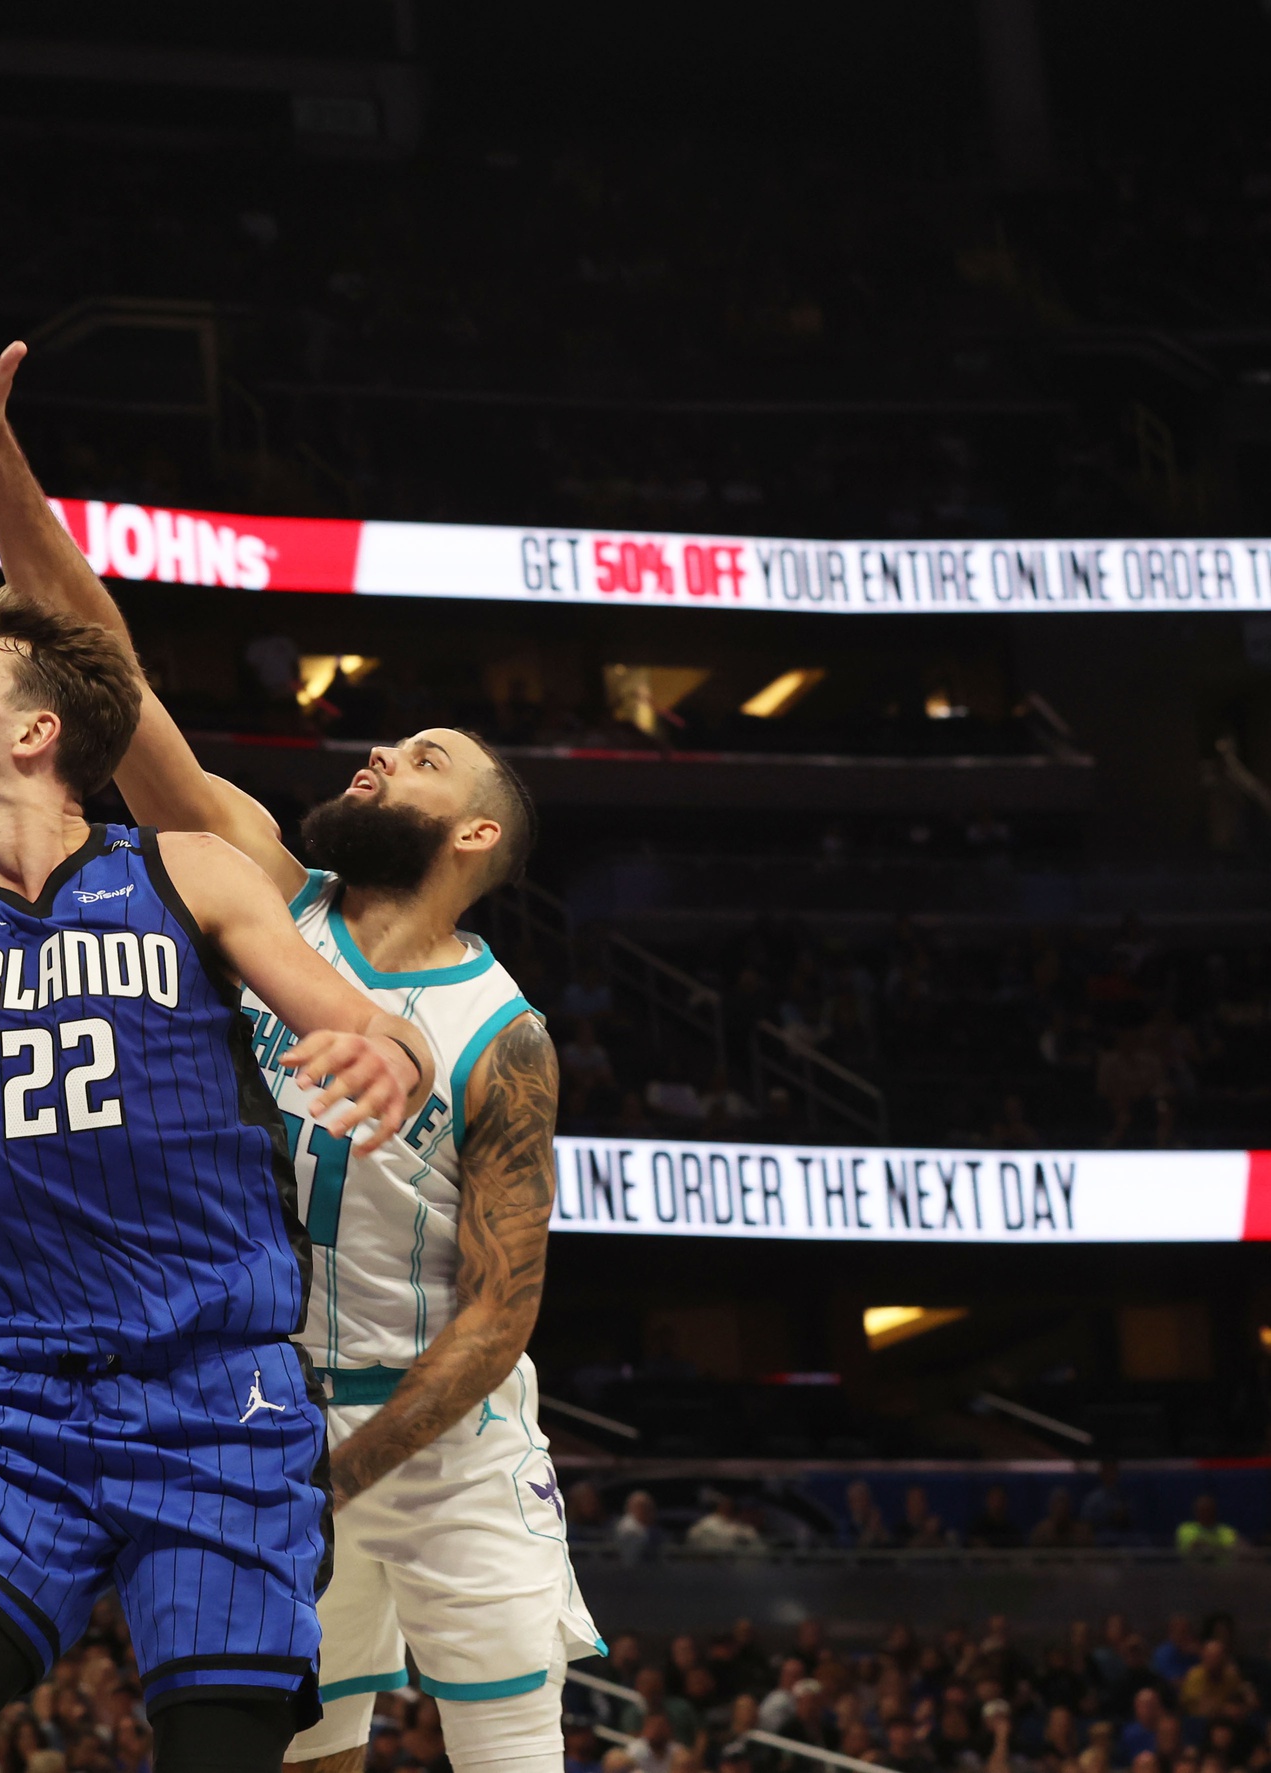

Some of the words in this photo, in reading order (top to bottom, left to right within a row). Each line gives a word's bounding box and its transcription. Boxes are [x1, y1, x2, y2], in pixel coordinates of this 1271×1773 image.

[84, 500, 270, 590] JOHNS
[521, 536, 580, 591] GET
[594, 540, 675, 595] 50%
[683, 545, 746, 597] OFF
[755, 548, 849, 601] YOUR
[860, 550, 979, 602] ENTIRE
[992, 550, 1110, 601] ONLINE
[1123, 549, 1237, 600] ORDER
[1247, 548, 1271, 600] T
[72, 883, 135, 904] Disney
[0, 1016, 124, 1140] 22
[651, 1151, 787, 1227] ORDER
[796, 1156, 873, 1229] THE
[884, 1158, 984, 1230] NEXT
[999, 1161, 1077, 1231] DAY
